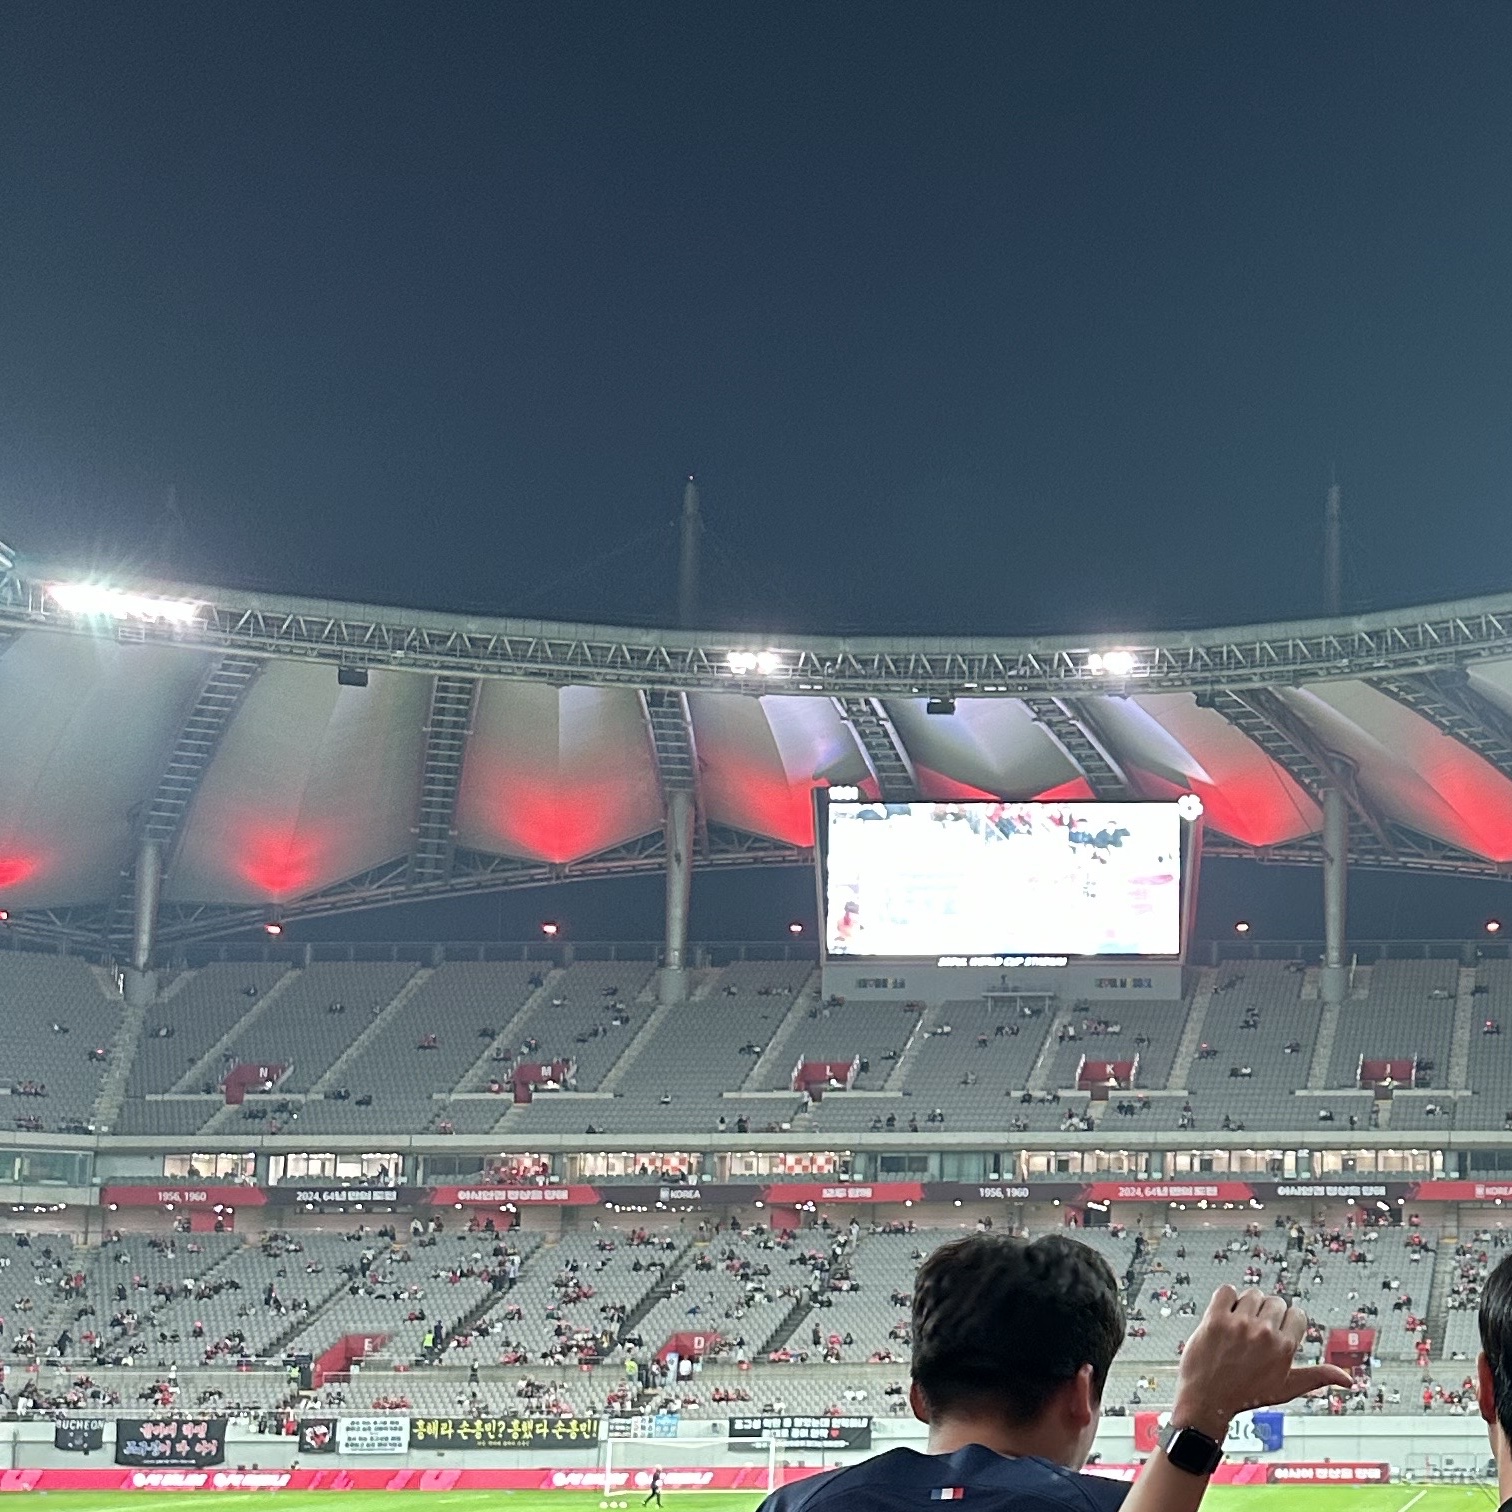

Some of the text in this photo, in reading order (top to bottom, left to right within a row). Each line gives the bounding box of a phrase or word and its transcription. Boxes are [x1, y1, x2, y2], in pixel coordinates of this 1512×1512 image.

[259, 1067, 269, 1078] N
[541, 1066, 553, 1077] M
[826, 1065, 834, 1076] L
[1105, 1063, 1115, 1075] K
[157, 1191, 207, 1203] 1956, 1960
[296, 1191, 322, 1202] 2024,
[670, 1188, 701, 1199] KOREA
[979, 1187, 1029, 1199] 1956, 1960
[1118, 1187, 1144, 1198] 2024,
[694, 1337, 704, 1349] D
